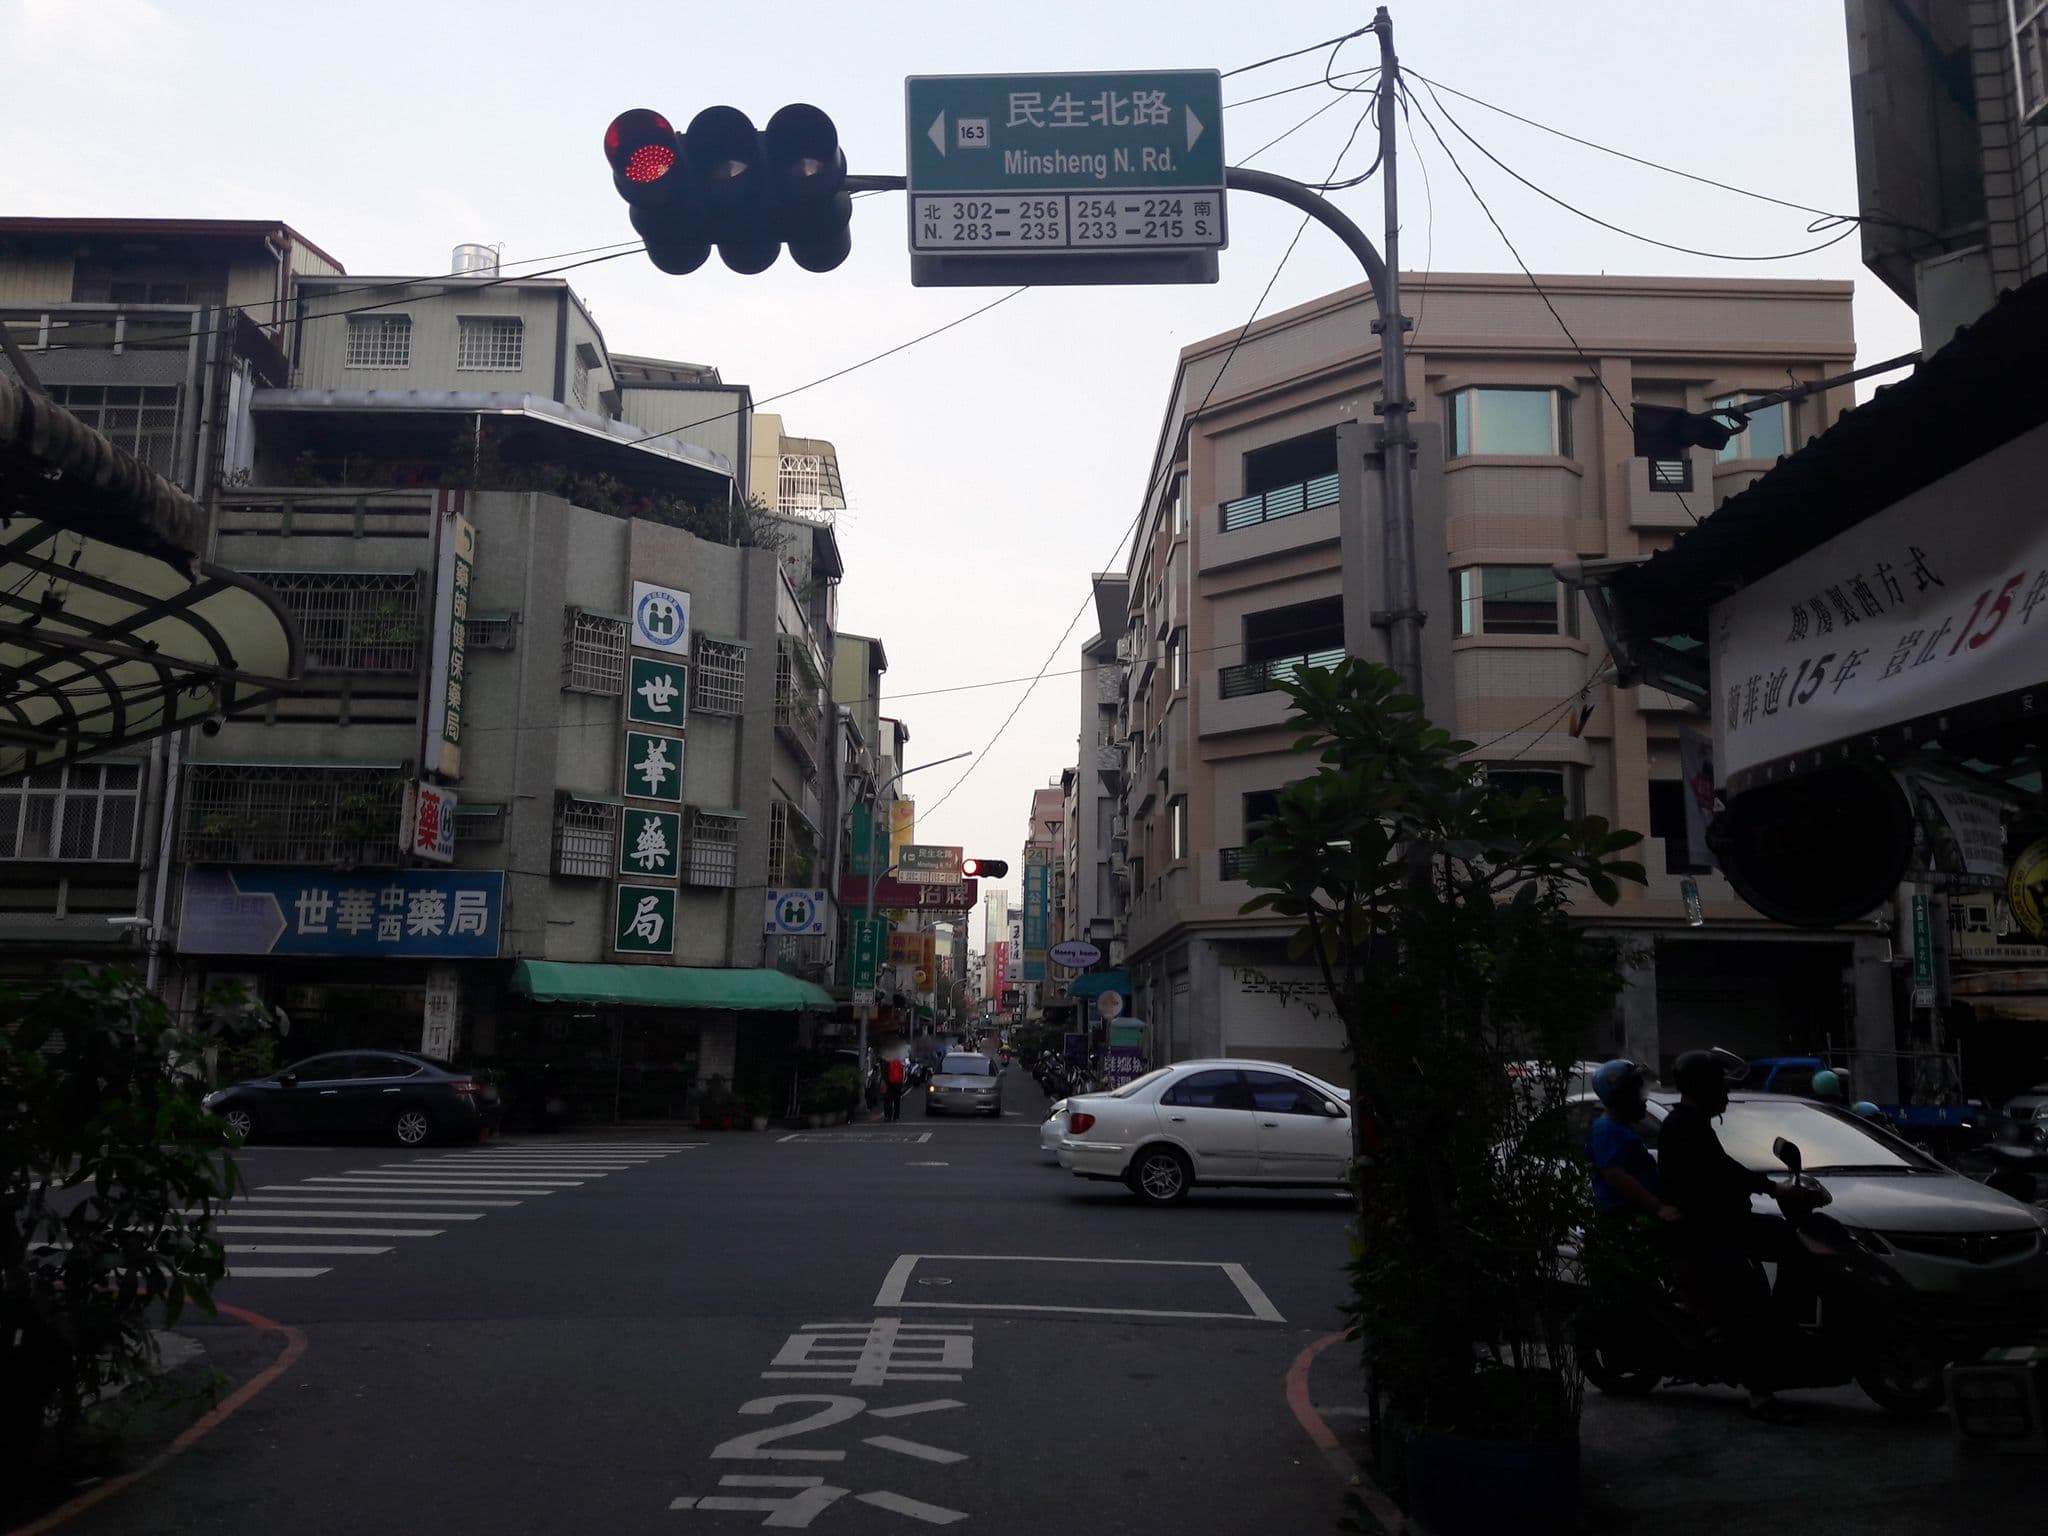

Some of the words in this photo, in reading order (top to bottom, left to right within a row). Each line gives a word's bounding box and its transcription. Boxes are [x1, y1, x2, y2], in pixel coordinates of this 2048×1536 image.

[1005, 91, 1172, 128] 民生北路
[960, 126, 984, 140] 163
[1004, 149, 1107, 179] Minsheng
[1114, 149, 1135, 172] N.
[1142, 147, 1177, 171] Rd.
[923, 203, 941, 220] 北
[1193, 200, 1211, 217] 南
[923, 223, 943, 240] N.
[1194, 219, 1213, 236] S.
[623, 674, 680, 945] 世華藥局
[417, 790, 440, 851] 藥
